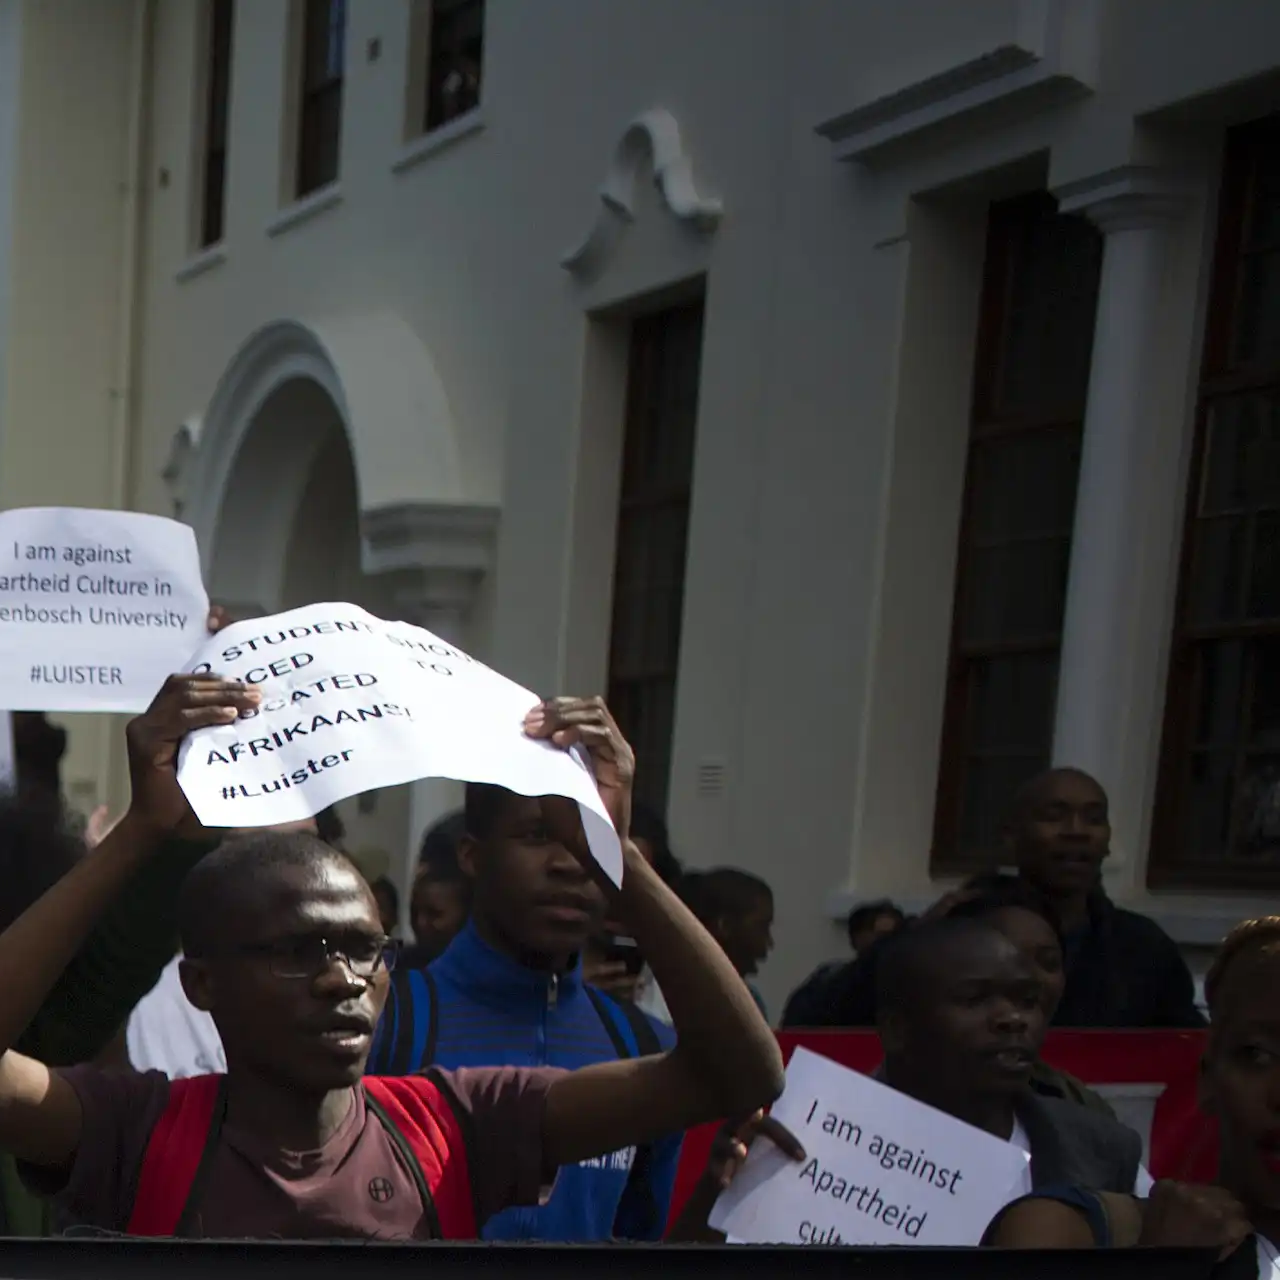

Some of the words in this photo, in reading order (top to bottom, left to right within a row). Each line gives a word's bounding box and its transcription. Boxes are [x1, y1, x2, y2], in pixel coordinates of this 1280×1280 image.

[13, 541, 20, 560] I
[25, 547, 56, 561] am
[62, 543, 133, 566] against
[76, 575, 150, 597] Culture
[155, 578, 172, 596] in
[88, 606, 188, 631] University
[221, 619, 374, 662] STUDENT
[29, 664, 123, 685] #LUISTER
[219, 749, 355, 800] #Luister
[806, 1098, 819, 1125] I
[821, 1112, 862, 1147] am
[868, 1134, 963, 1196] against
[798, 1157, 928, 1239] Apartheid
